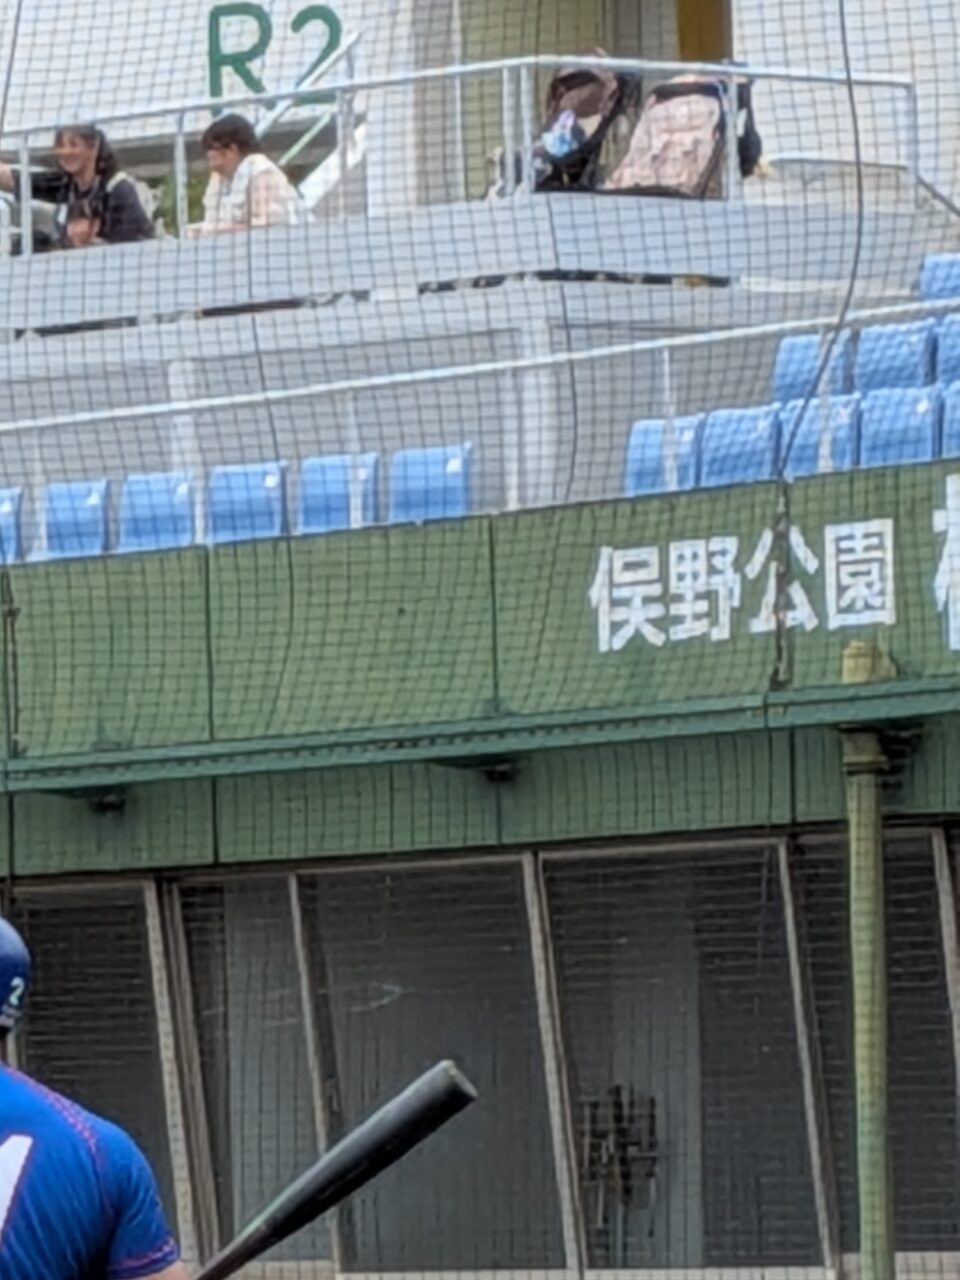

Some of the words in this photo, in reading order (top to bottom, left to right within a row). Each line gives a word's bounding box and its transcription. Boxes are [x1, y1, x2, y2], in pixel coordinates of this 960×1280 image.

[208, 2, 342, 116] R2
[589, 518, 897, 652] 俣野公園
